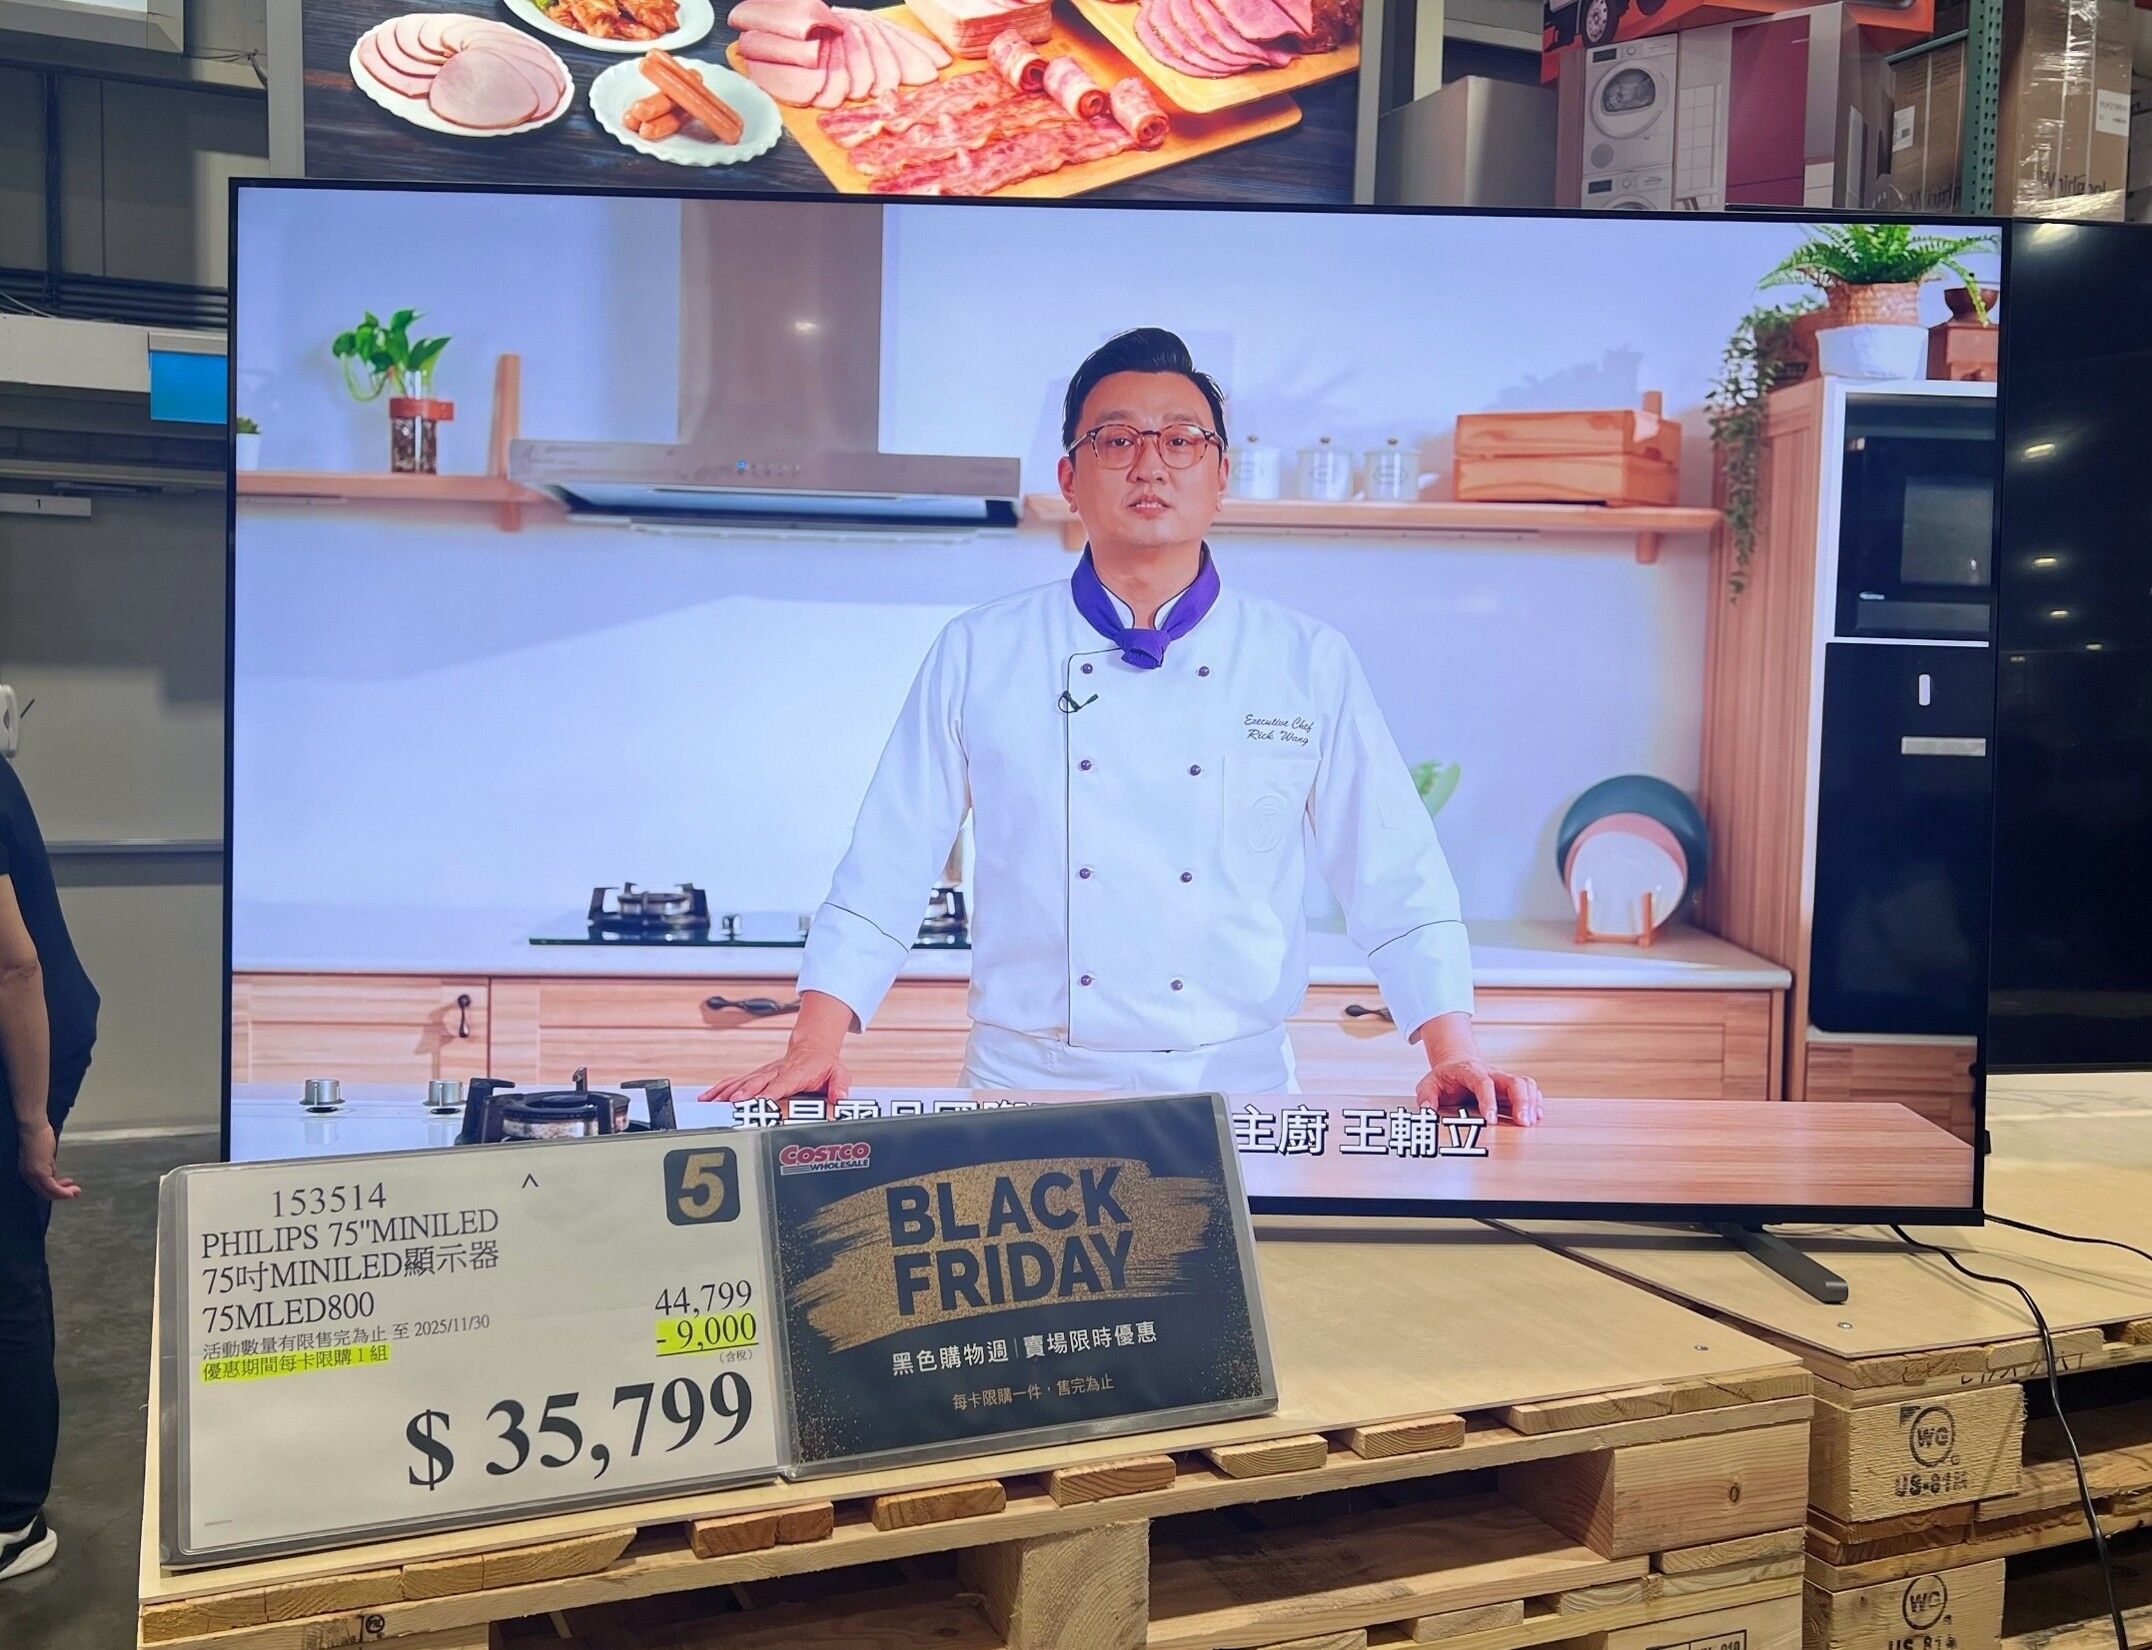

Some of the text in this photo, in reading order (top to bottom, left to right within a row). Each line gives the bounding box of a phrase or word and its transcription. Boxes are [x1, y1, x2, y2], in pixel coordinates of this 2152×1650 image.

[1243, 713, 1315, 734] Executive Chef
[1246, 728, 1310, 747] Rick Wang
[1232, 1104, 1489, 1157] 主廚 王輔立
[779, 1142, 871, 1166] COSTCO
[809, 1159, 869, 1171] WHOLESALE
[272, 1182, 387, 1218] 153514
[677, 1152, 725, 1218] 5
[886, 1166, 1132, 1247] BLACK
[201, 1208, 499, 1259] PHILIPS 75"MINILED
[202, 1240, 500, 1295] 75吋MINILED顯示器
[893, 1230, 1134, 1316] FRIDAY
[202, 1291, 375, 1333] 75MLED800
[654, 1280, 752, 1318] 44,799
[203, 1314, 490, 1361] 活動數量有限售完為止 至 2025/11/30
[203, 1347, 352, 1382] 優惠期間每卡限購
[370, 1344, 390, 1363] 組
[485, 1371, 752, 1480] 35,799
